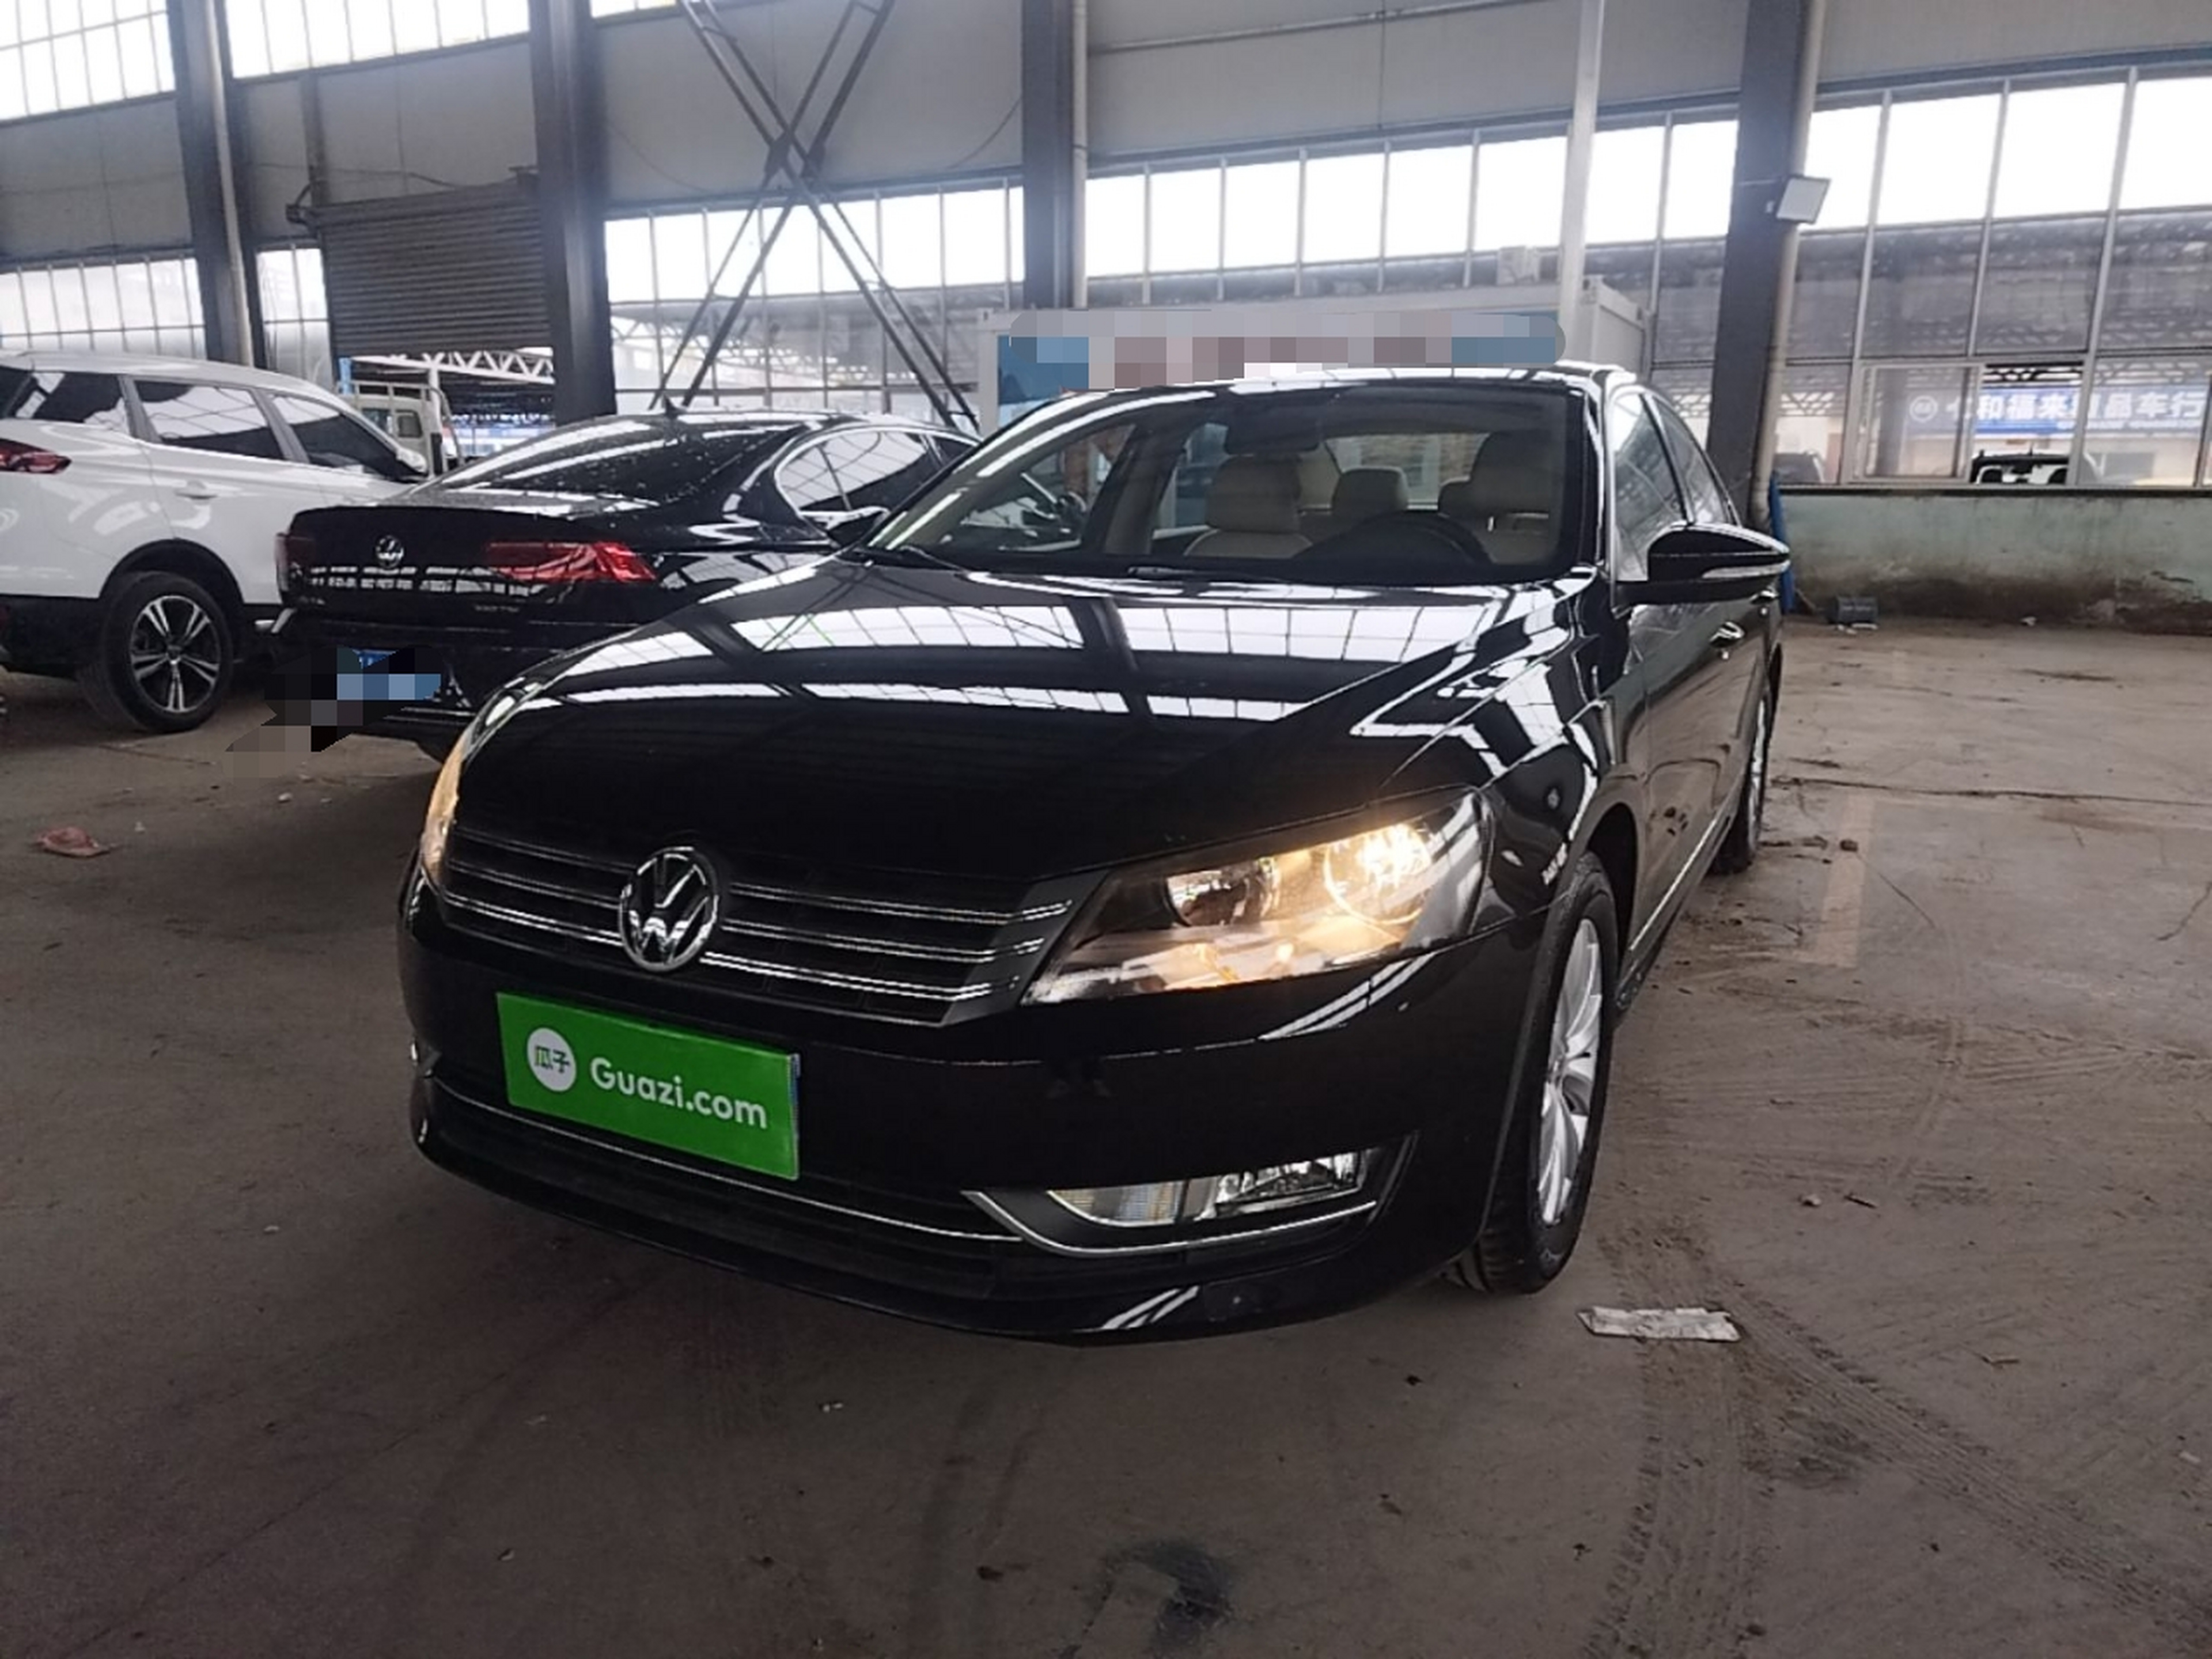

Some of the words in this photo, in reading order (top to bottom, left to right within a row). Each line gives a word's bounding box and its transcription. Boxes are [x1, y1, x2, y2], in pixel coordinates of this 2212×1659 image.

[1946, 391, 2206, 421] 仁和福来品车行
[534, 1045, 570, 1073] 瓜子
[590, 1057, 767, 1129] Guazi.com
